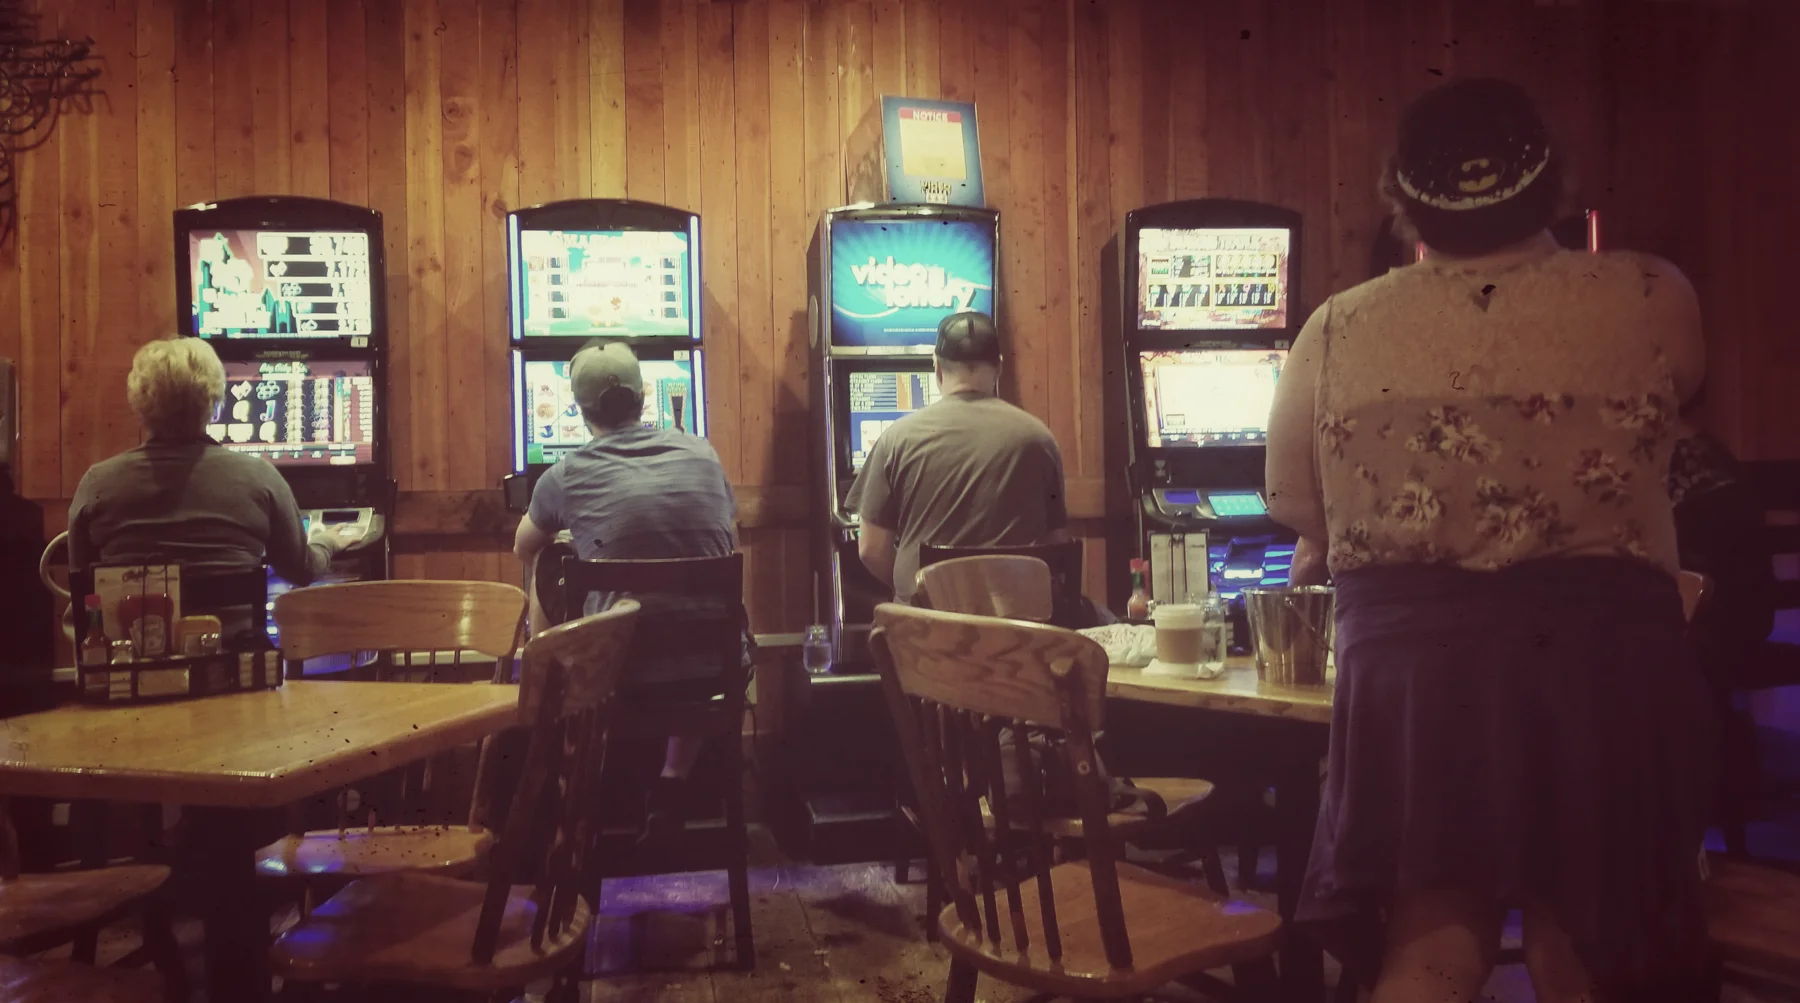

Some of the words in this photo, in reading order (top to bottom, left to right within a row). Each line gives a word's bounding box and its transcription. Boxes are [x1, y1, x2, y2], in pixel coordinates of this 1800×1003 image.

[913, 110, 948, 122] NOTICE
[850, 256, 927, 286] video
[260, 400, 275, 421] J
